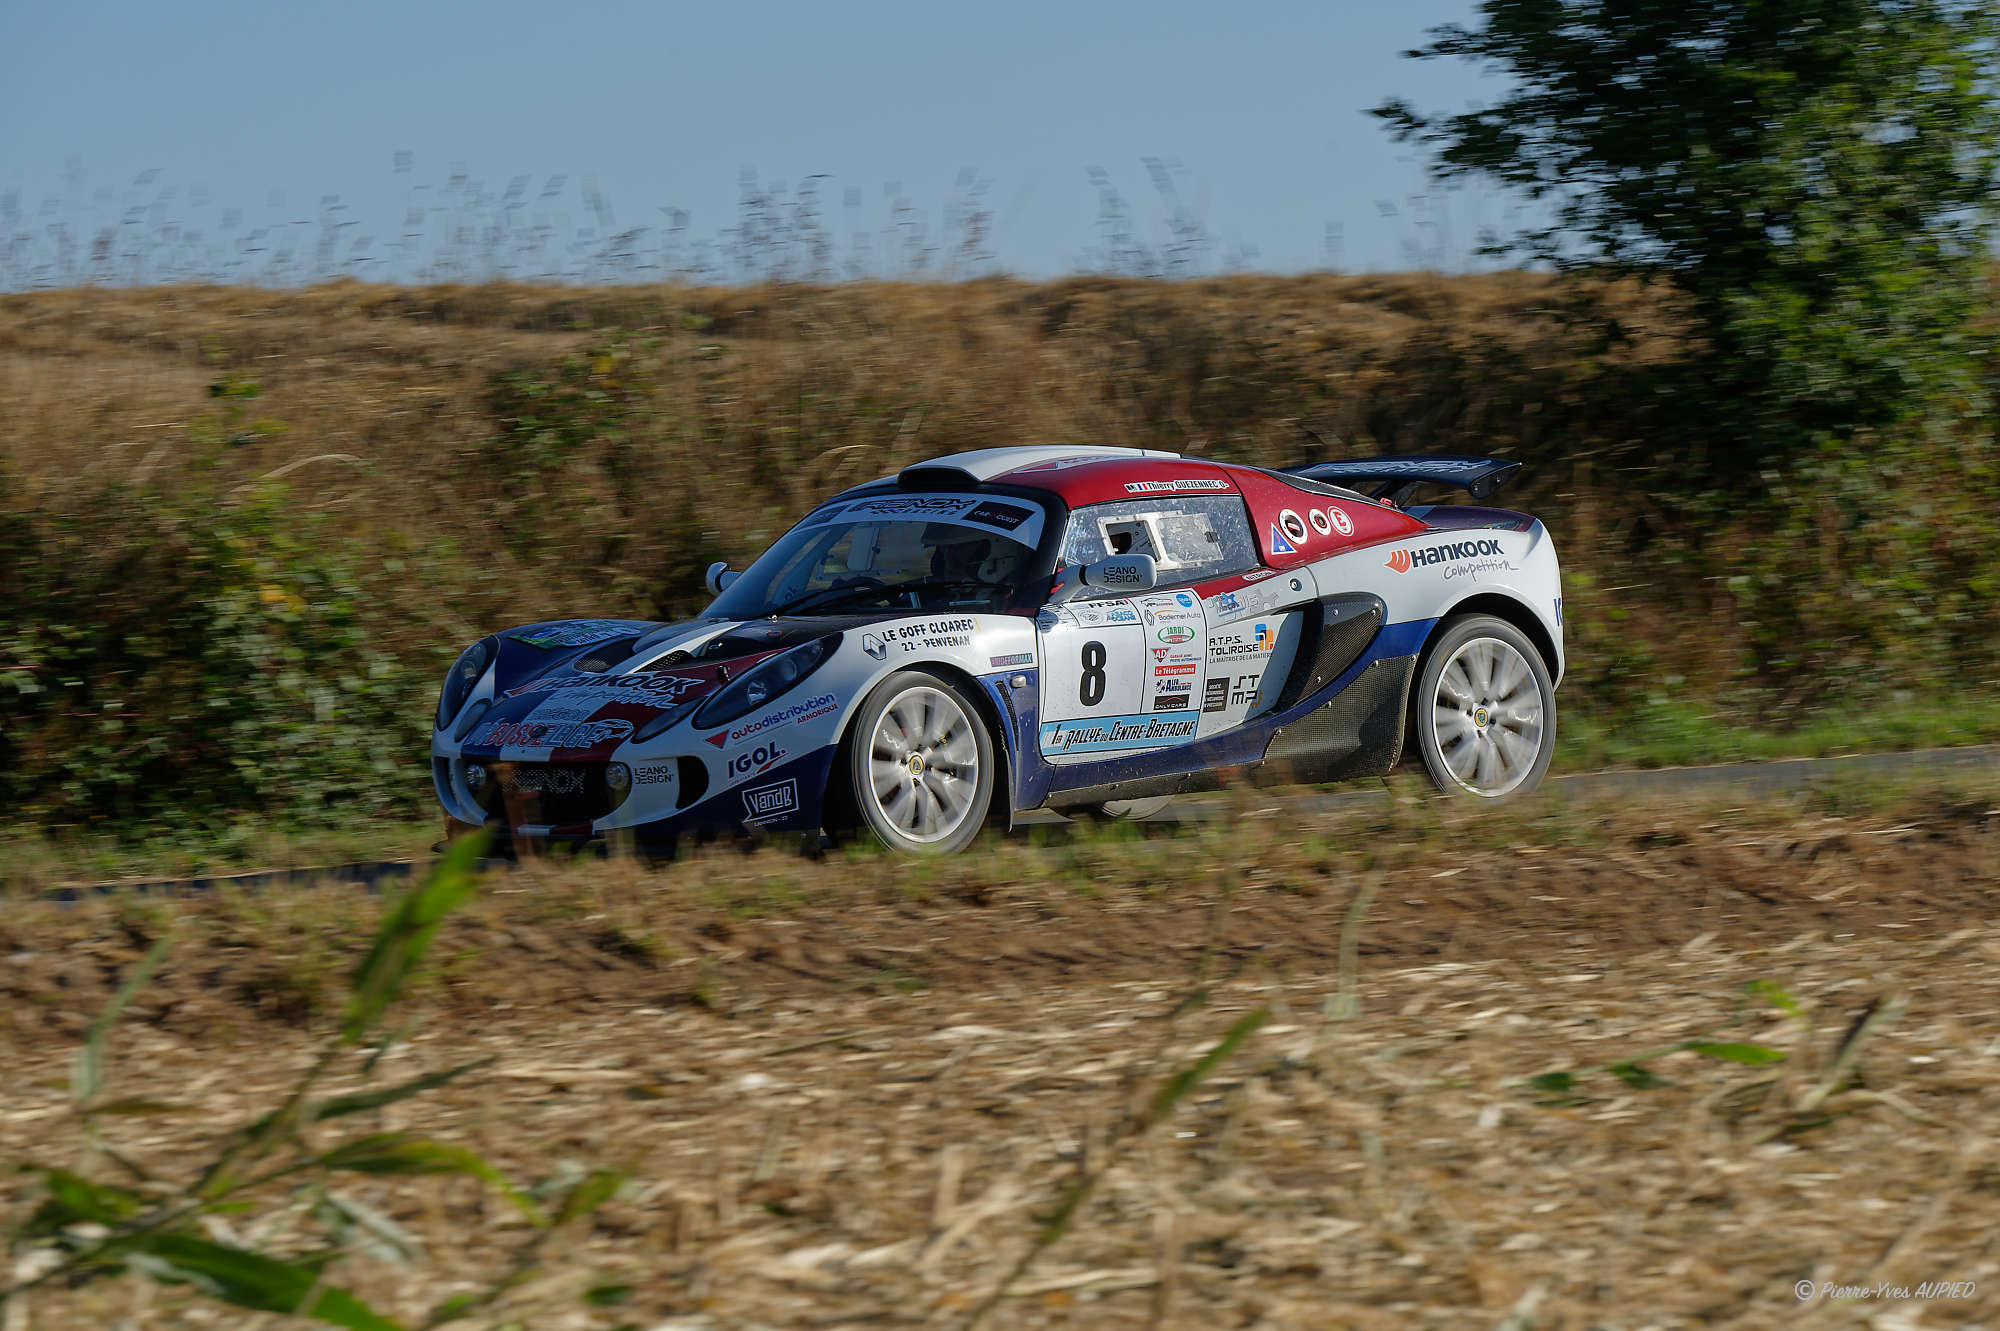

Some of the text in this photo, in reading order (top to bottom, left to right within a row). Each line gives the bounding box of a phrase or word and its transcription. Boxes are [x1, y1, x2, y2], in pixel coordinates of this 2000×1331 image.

[1148, 482, 1174, 491] Thierry
[1174, 480, 1218, 489] GUEZENNEC
[1103, 566, 1137, 576] LEANO
[1103, 574, 1141, 583] DESIGN
[882, 618, 974, 643] LE GOFF CLOAREC
[901, 641, 916, 652] 22
[923, 635, 971, 648] PENVENAN
[1209, 635, 1243, 646] A.T.P.S.
[1209, 643, 1259, 656] TOLIROISE
[1079, 640, 1107, 707] 8
[1155, 665, 1195, 675] Le Télégramme
[731, 693, 834, 740] autodistribution
[797, 703, 839, 725] ARMORIQUE
[1063, 727, 1102, 750] RALLYE
[1108, 719, 1196, 742] CENTRE-BRETAGNE
[634, 765, 669, 776] LEANO
[634, 773, 673, 785] DESIGN
